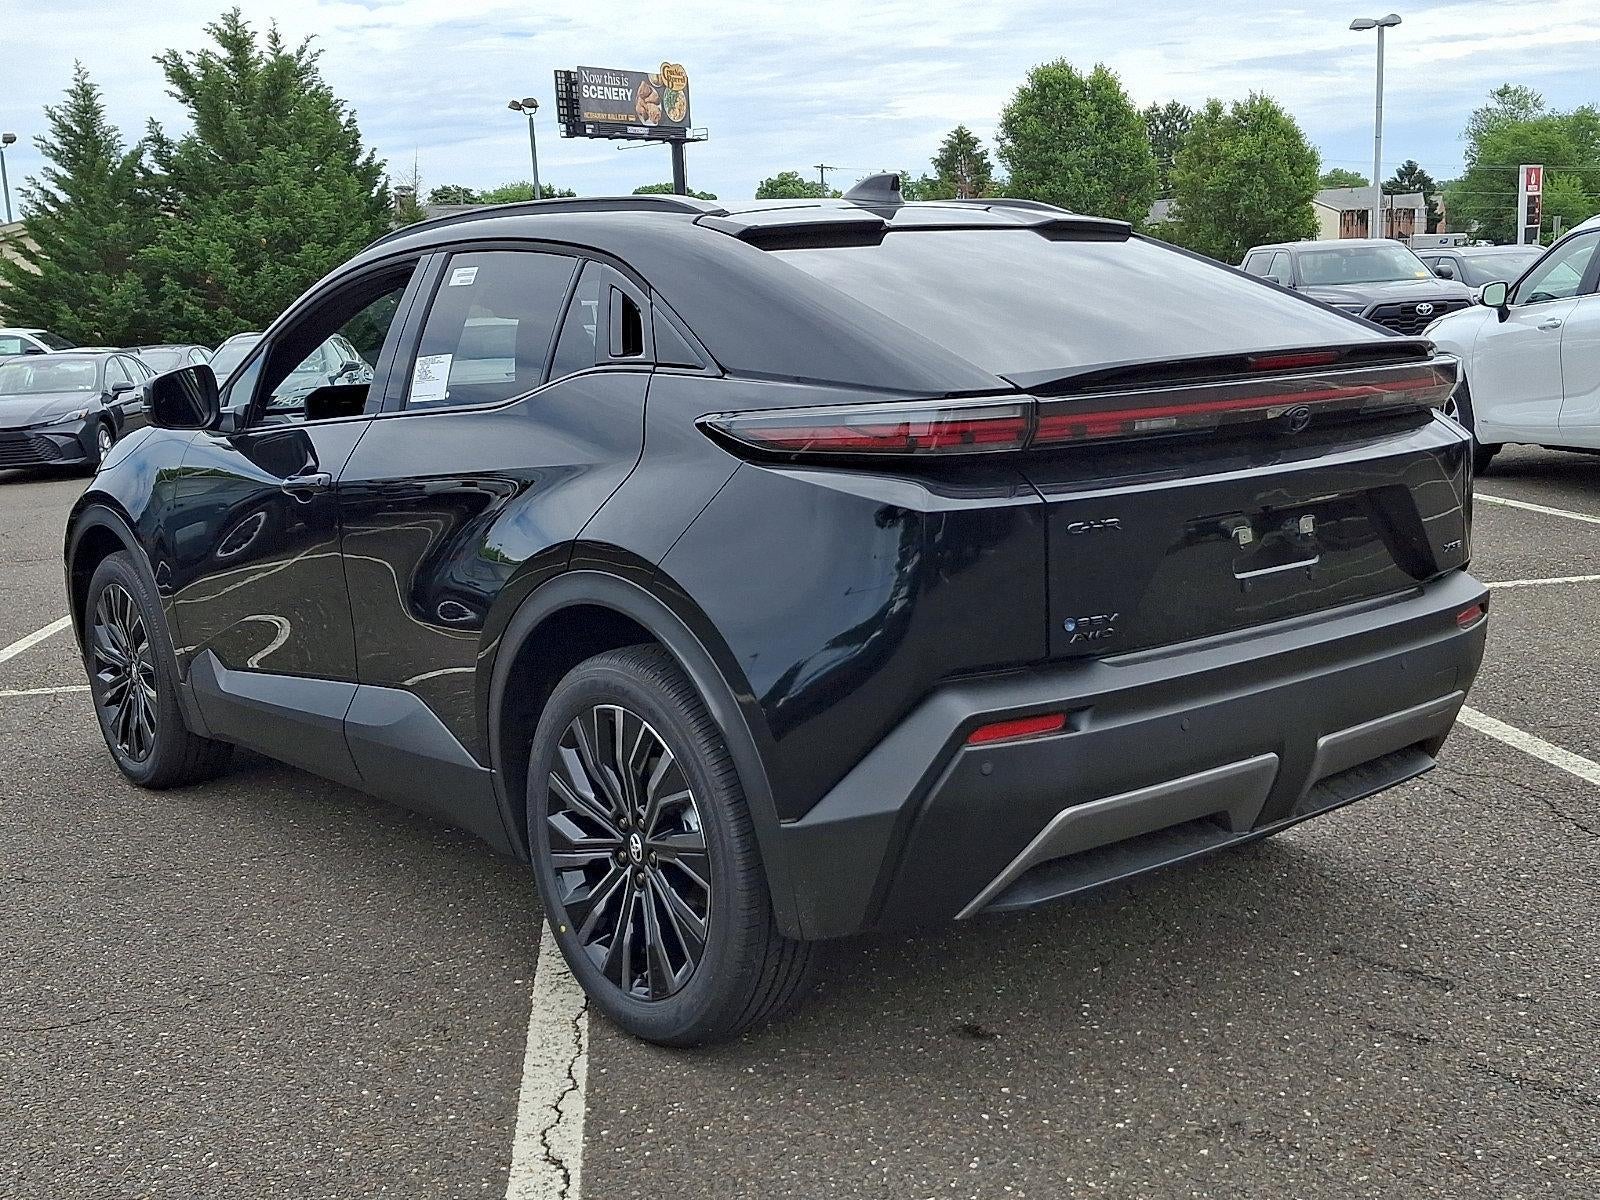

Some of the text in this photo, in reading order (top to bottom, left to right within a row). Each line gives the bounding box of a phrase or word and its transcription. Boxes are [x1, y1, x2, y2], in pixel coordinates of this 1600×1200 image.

[580, 69, 629, 87] Now this is
[582, 84, 633, 102] SCENERY
